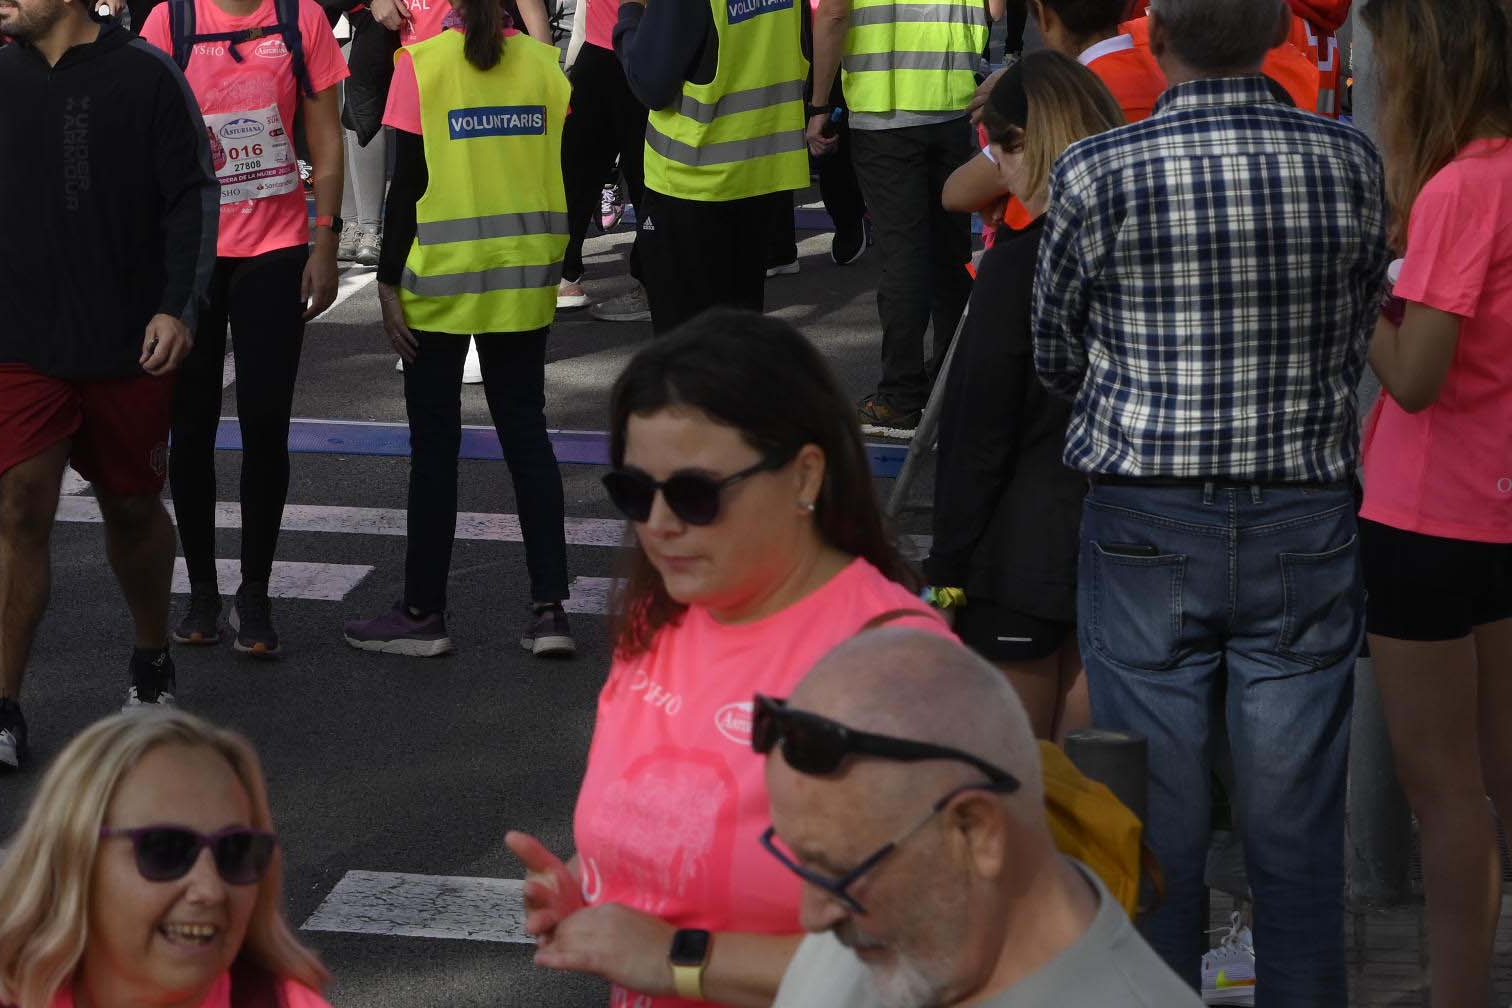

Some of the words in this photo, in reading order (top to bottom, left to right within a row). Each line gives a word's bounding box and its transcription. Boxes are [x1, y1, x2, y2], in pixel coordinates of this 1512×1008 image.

[193, 44, 225, 57] YSHO
[451, 113, 543, 132] VOLUNTARIS
[228, 143, 264, 161] 016
[234, 160, 261, 172] 27808
